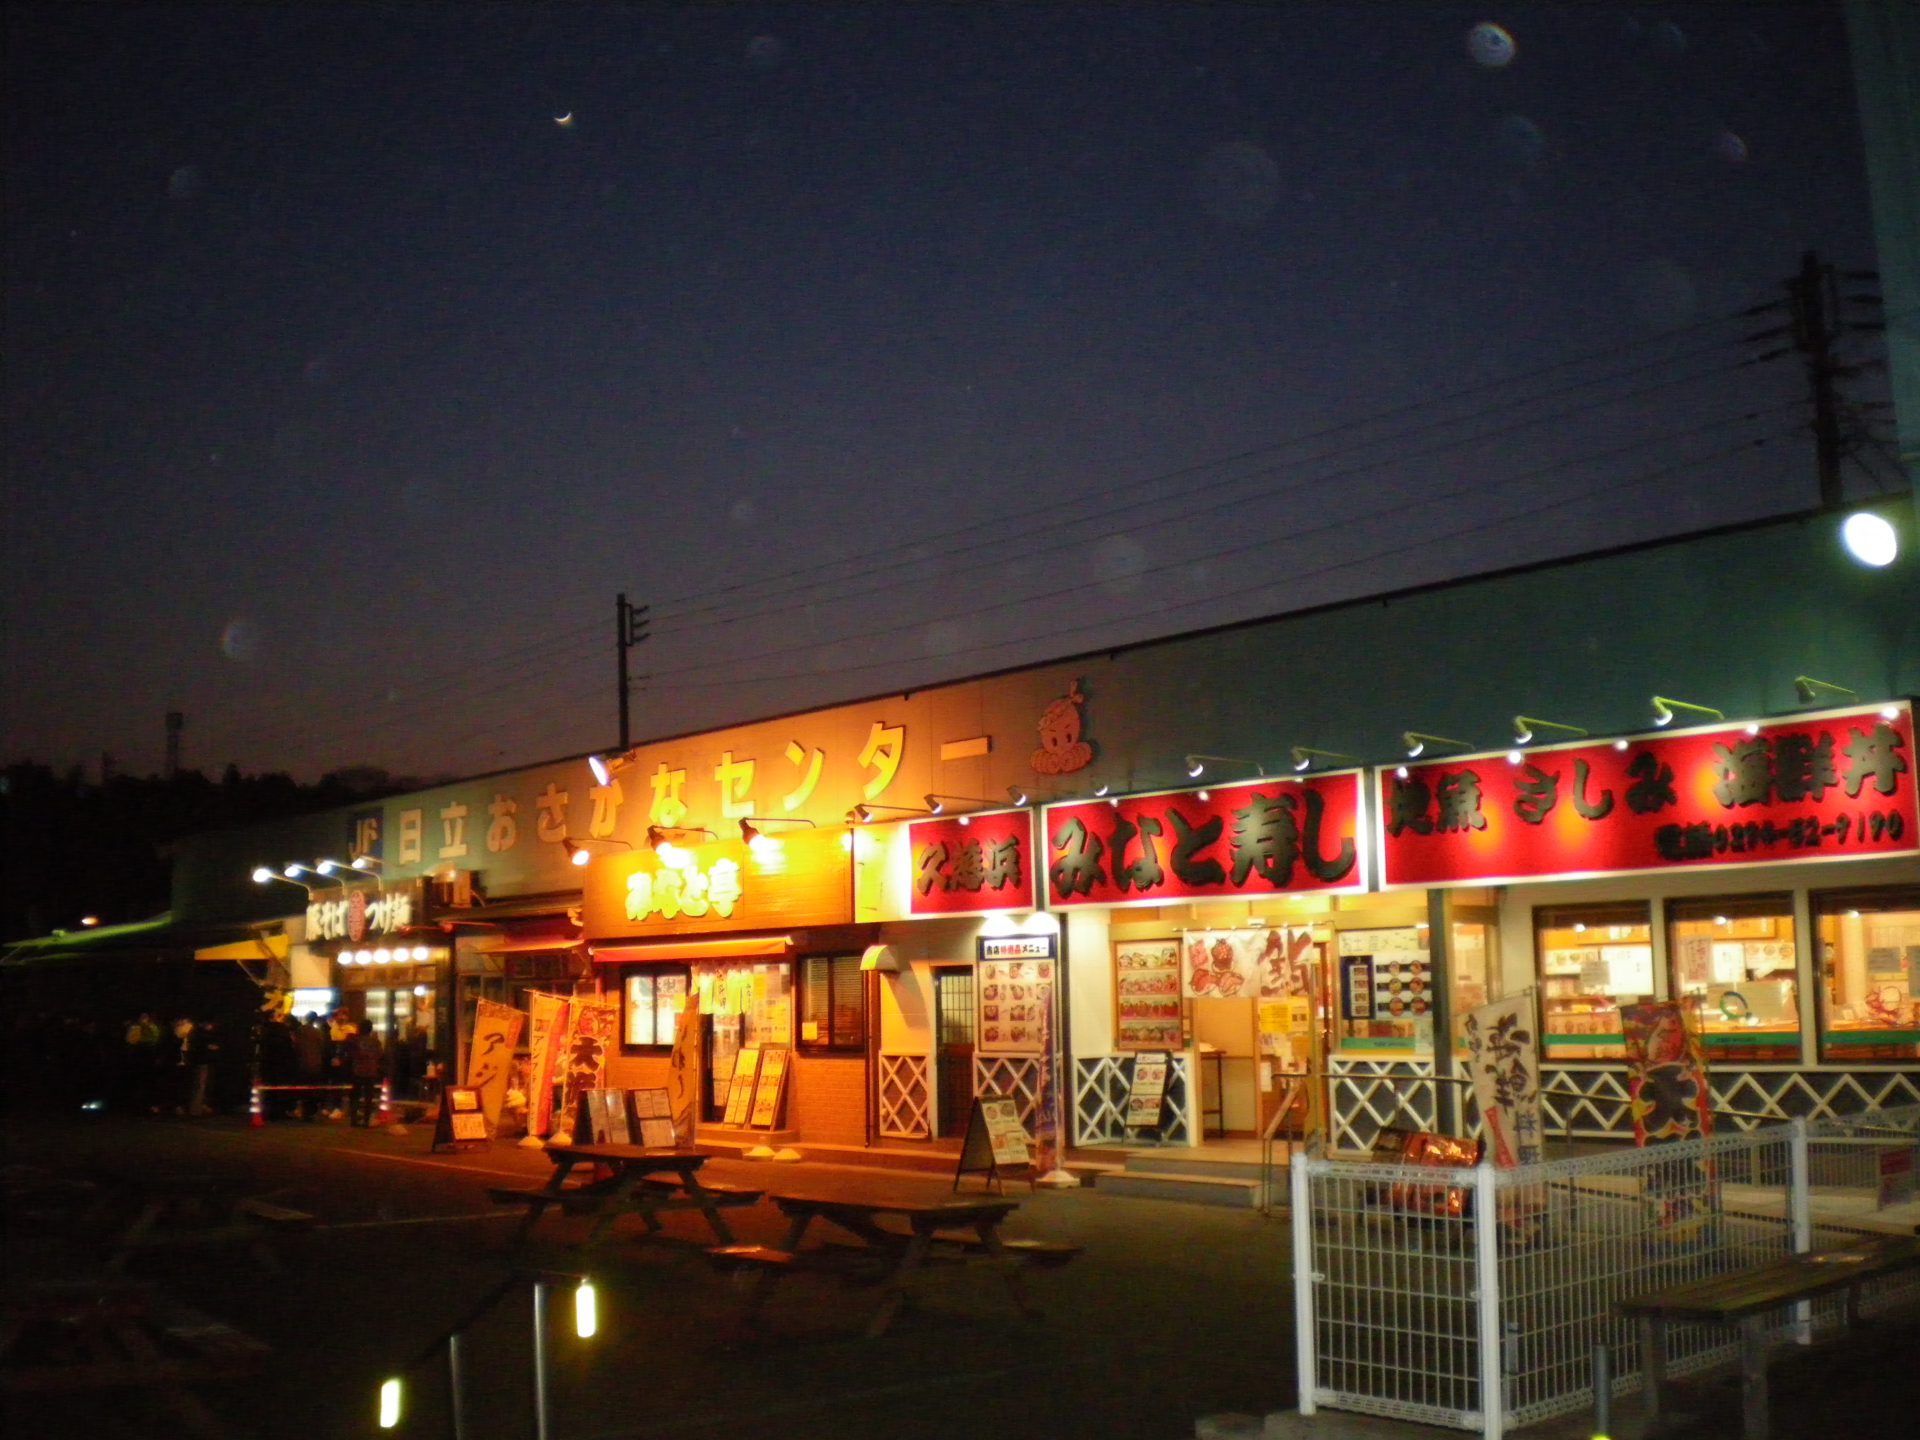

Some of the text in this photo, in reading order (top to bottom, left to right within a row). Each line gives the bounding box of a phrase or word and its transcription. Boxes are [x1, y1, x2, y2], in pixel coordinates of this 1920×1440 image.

[399, 721, 992, 864] 日立おさかなセンター
[1386, 721, 1908, 838] 地魚 さしみ 海鮮丼
[1049, 792, 1356, 899] みなと寿し
